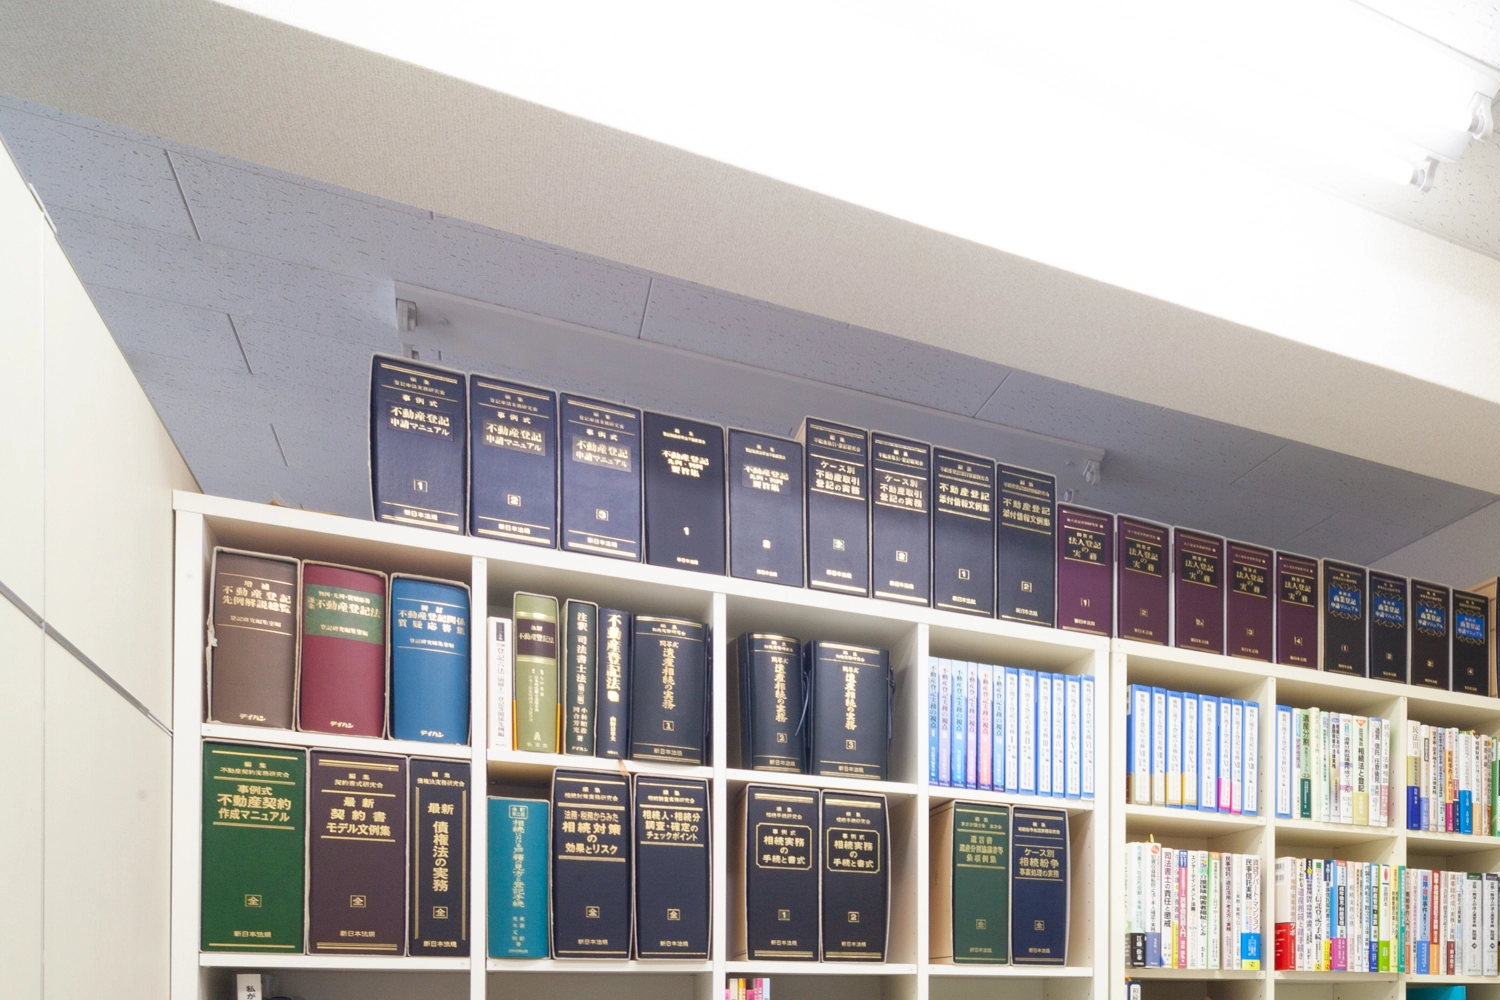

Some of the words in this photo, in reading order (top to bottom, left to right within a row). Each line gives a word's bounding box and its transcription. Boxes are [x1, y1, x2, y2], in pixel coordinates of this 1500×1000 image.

[390, 406, 450, 427] 不動産登記
[497, 411, 531, 425] 事例式
[390, 417, 450, 437] 申請マニュアル
[486, 423, 542, 443] 不動産登記
[586, 428, 618, 441] 事例式
[486, 433, 542, 452] 申請マニュアル
[576, 440, 628, 459] 不動産登記
[575, 450, 628, 468] 申請マニュアル
[662, 450, 709, 466] 不動産登記
[743, 465, 789, 481] 不動産登記
[815, 470, 860, 486] 不動産取引
[815, 480, 860, 495] 登記の実務
[884, 474, 918, 488] ケース別
[879, 484, 923, 499] 不動産取引
[939, 483, 990, 501] 不動産登記
[879, 493, 923, 508] 登記の実務
[1003, 498, 1050, 515] 不動産登記
[1003, 509, 1050, 527] 添付情報文例集
[498, 523, 530, 534] 新日本法規
[587, 537, 618, 548] 新日本法規
[1068, 536, 1101, 550] 法人登記
[1129, 548, 1158, 561] 法人登記
[1185, 560, 1214, 572] 法人登記
[1189, 572, 1211, 583] 実務
[1236, 571, 1264, 584] 法人登記
[222, 584, 291, 604] 不動産登記
[1284, 581, 1311, 593] 法人登記
[222, 595, 292, 614] 先例解説総覧
[1288, 592, 1308, 603] 実務
[1333, 595, 1357, 606] 商業登記
[316, 600, 381, 619] 不動産登記法
[1377, 604, 1400, 615] 商業登記
[398, 609, 466, 626] 不動産登記関係
[577, 612, 588, 632] 注釈
[1420, 612, 1441, 623] 商業登記
[398, 619, 466, 635] 質疑応答集
[1460, 620, 1481, 632] 商業登記
[518, 632, 555, 644] 不動産登記法
[576, 635, 588, 684] 司法書士法
[606, 614, 621, 691] 不動産登記法
[661, 648, 676, 710] 遺産相続の実務
[774, 664, 788, 723] 遺産相続の実務
[845, 673, 858, 731] 遺産相続の実務
[217, 794, 292, 810] 不動産契約
[344, 797, 375, 809] 最新
[427, 803, 454, 815] 最新
[218, 808, 290, 823] 作成マニュアル
[331, 808, 386, 823] 契約書
[564, 809, 619, 823] 法務・税務からみた
[642, 810, 701, 822] 相続人・相続分
[326, 822, 391, 837] モデル文例集
[562, 821, 621, 836] 相続対策
[645, 821, 699, 832] 調査・確定の
[646, 831, 698, 842] チェックポイント
[763, 835, 805, 848] 相続実務
[842, 833, 865, 842] 事例式
[565, 843, 618, 855] 効果とリスク
[834, 840, 874, 852] 相続実務
[1024, 848, 1054, 858] ケース別
[432, 820, 449, 892] 債権法の実務
[762, 853, 806, 866] 手続と書式
[833, 857, 874, 869] 手続と書式
[966, 853, 997, 865] 条項例集
[1019, 857, 1059, 868] 相続紛争
[233, 930, 272, 938] 新日本法規
[340, 930, 375, 938] 新日本法規
[423, 940, 457, 948] 新日本法規
[577, 938, 609, 946] 新日本法規
[771, 939, 798, 947] 新日本法規
[841, 940, 867, 948] 新日本法規
